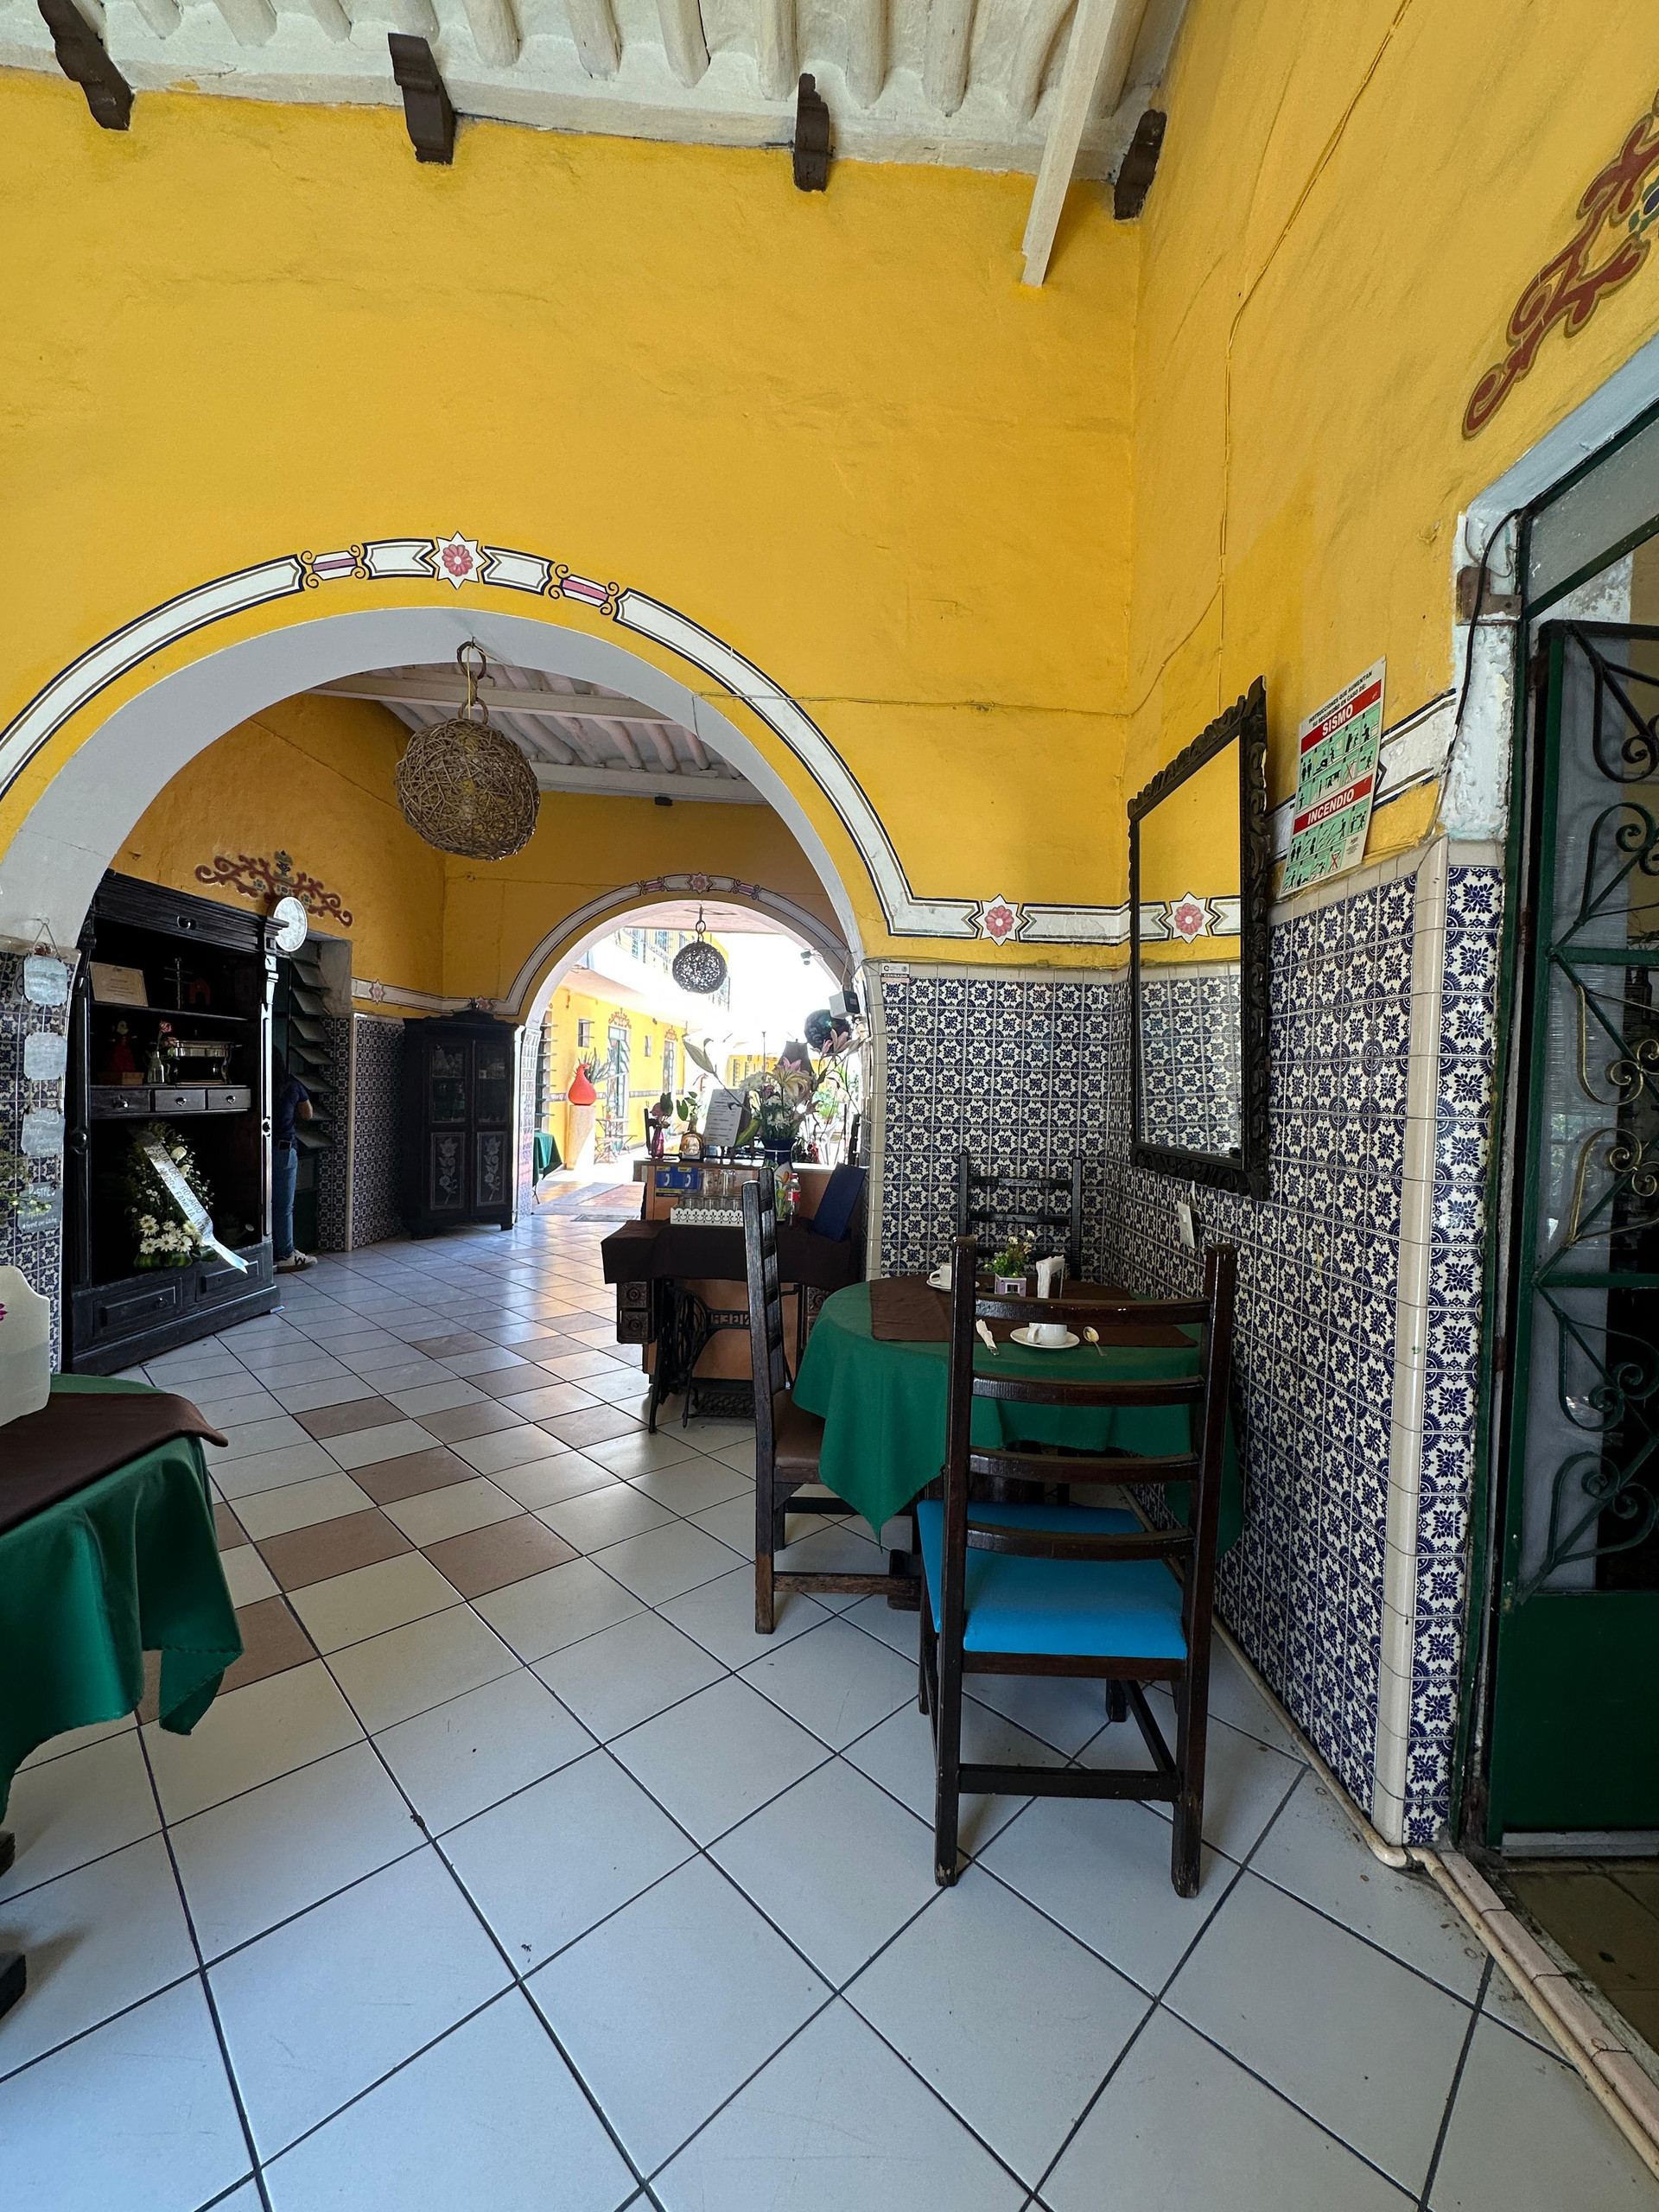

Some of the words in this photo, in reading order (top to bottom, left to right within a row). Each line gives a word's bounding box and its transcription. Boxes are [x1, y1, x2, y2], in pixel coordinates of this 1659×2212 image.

[1338, 689, 1348, 700] QUE
[1348, 671, 1373, 692] AUMENTAN
[1347, 689, 1358, 702] CASO
[1322, 703, 1353, 736] SISMO
[1307, 788, 1354, 825] INCENDIO
[168, 1166, 181, 1182] DEL
[181, 1185, 204, 1213] ROSARIO
